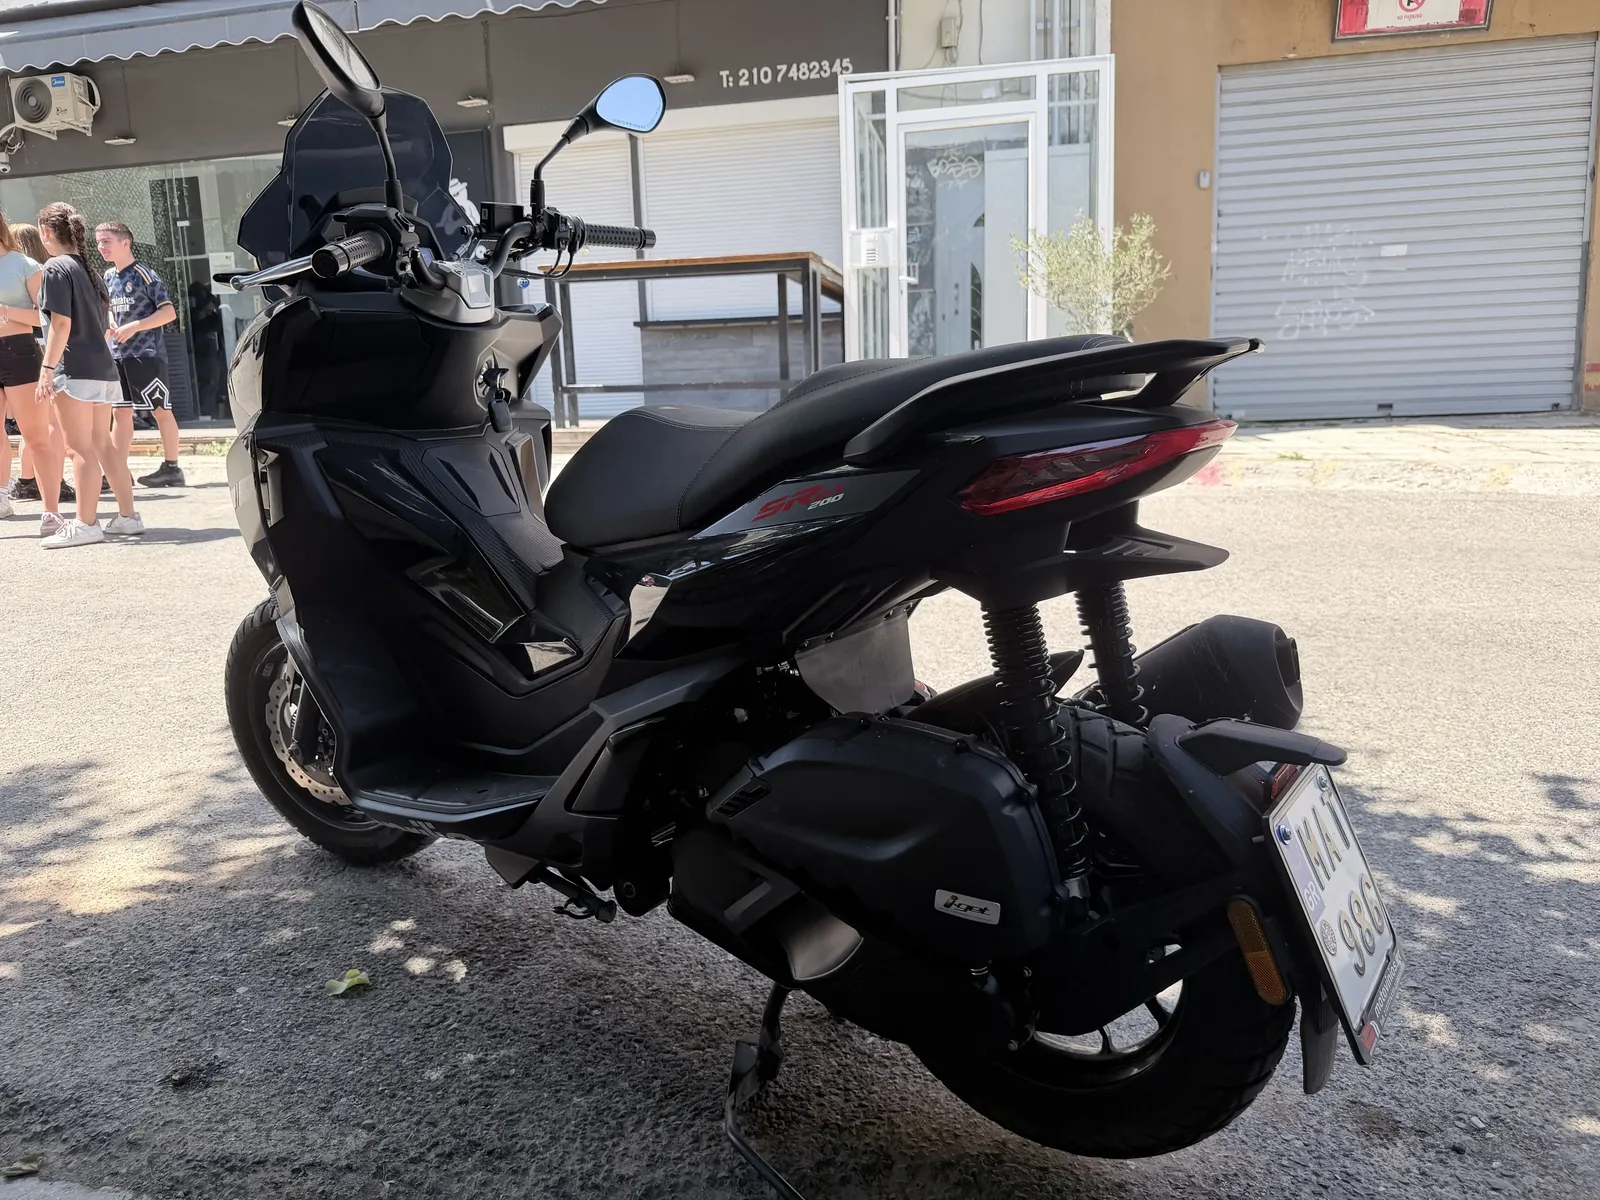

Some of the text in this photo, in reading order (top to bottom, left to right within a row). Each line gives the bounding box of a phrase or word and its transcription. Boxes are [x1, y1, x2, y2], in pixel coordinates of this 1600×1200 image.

[719, 58, 853, 88] T: 210 7482345
[807, 493, 844, 510] 200
[1303, 879, 1321, 911] GR
[1338, 873, 1384, 977] 986
